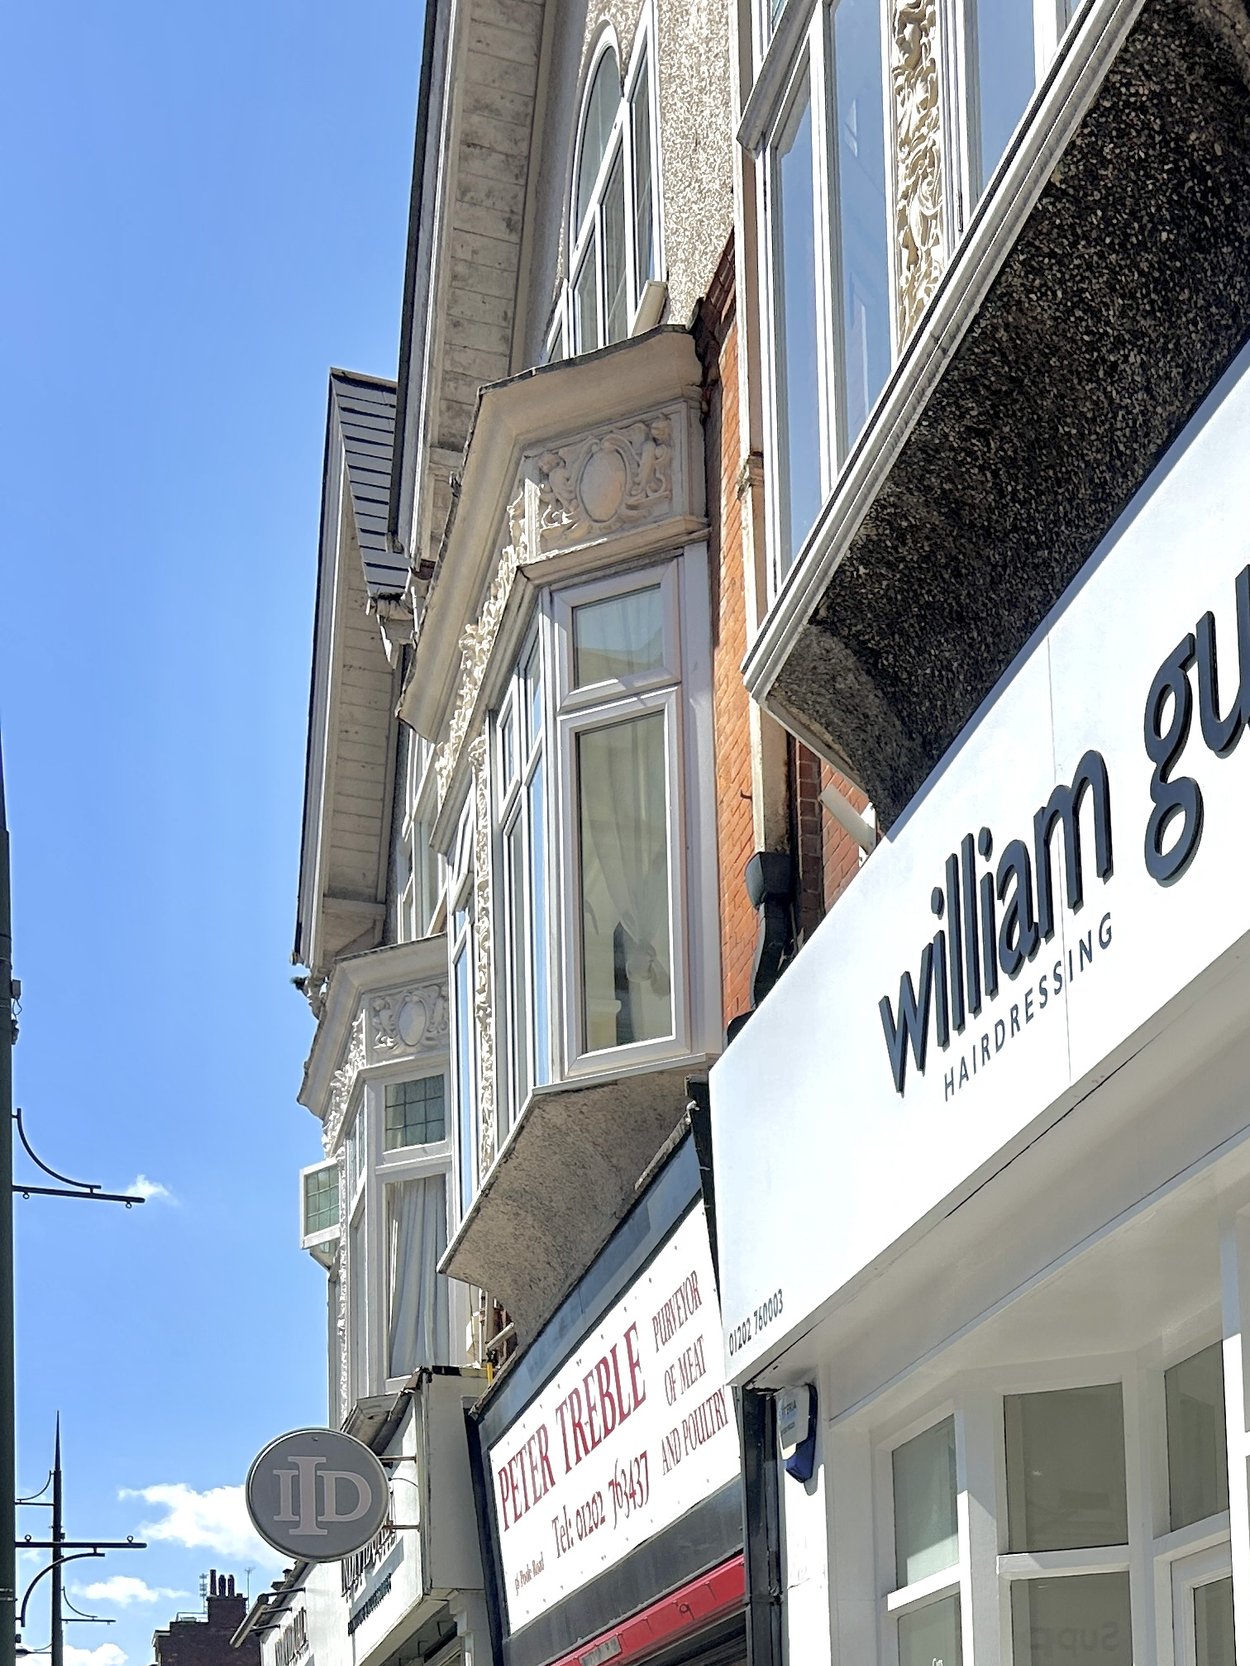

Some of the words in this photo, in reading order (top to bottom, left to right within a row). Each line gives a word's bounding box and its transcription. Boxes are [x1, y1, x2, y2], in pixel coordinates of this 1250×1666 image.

[878, 749, 1114, 1098] william
[944, 911, 1112, 1103] HAIRDRESSING
[651, 1270, 702, 1353] PURVEYOR
[728, 1317, 752, 1357] 01202
[754, 1288, 783, 1335] 760003
[664, 1360, 680, 1407] OF
[677, 1334, 707, 1397] MEAT
[498, 1423, 556, 1532] PETER
[555, 1321, 647, 1476] TREBLE
[661, 1428, 682, 1476] AND
[681, 1384, 729, 1460] POULTRY
[551, 1504, 574, 1559] Tel:
[575, 1491, 606, 1543] 01202
[608, 1449, 650, 1530] 763437
